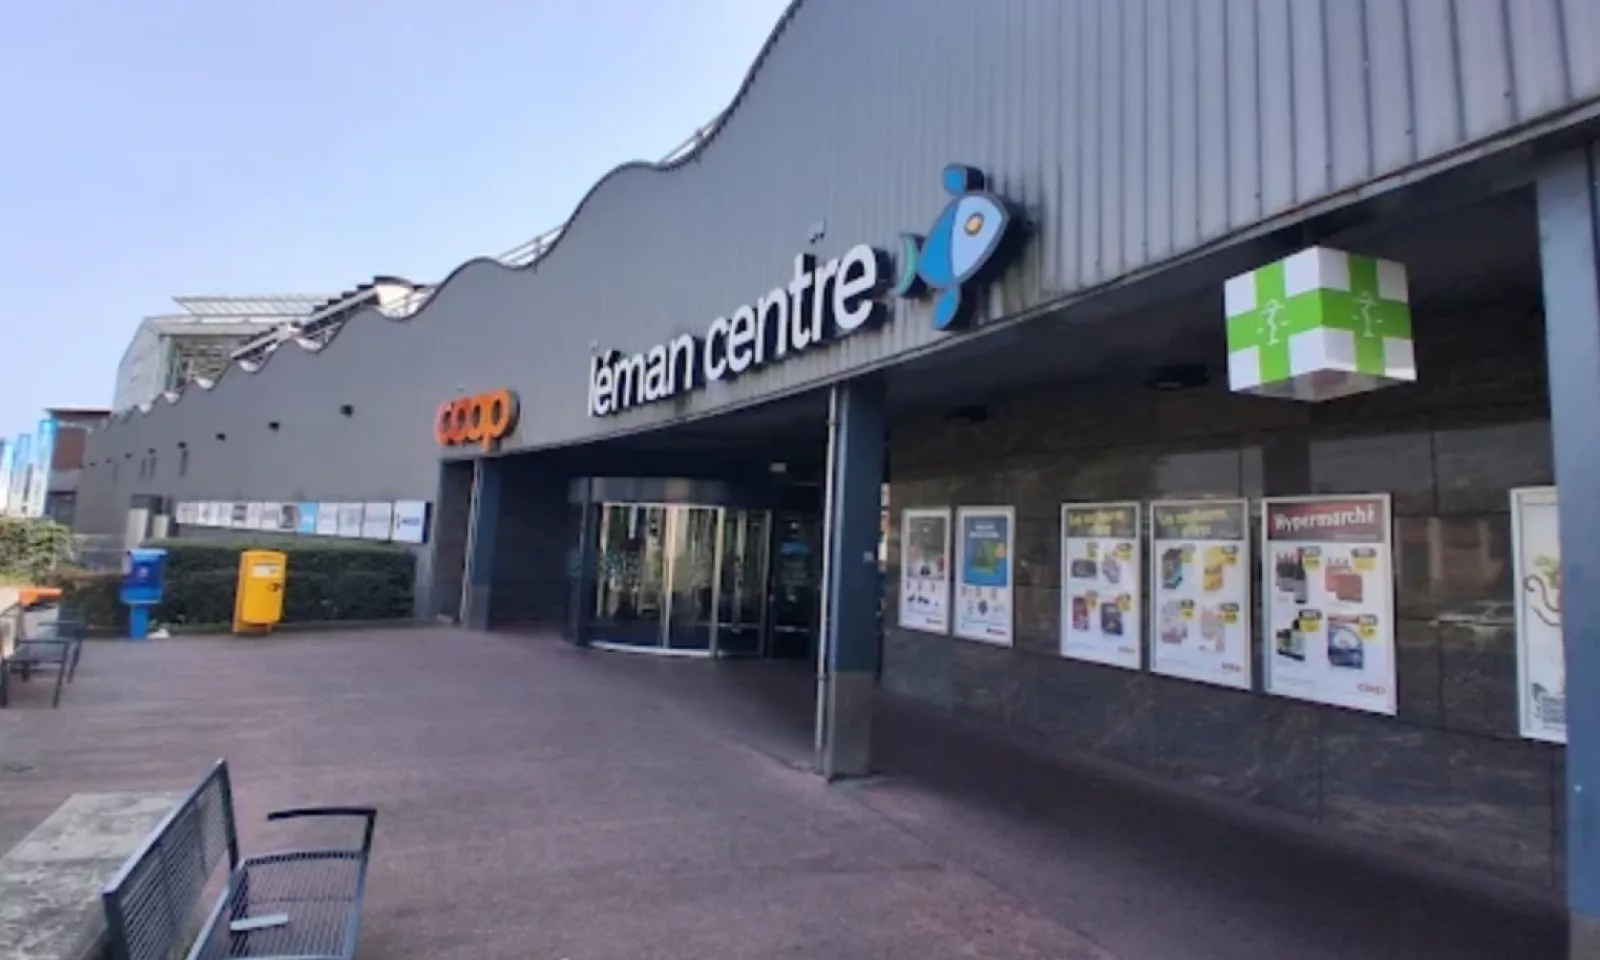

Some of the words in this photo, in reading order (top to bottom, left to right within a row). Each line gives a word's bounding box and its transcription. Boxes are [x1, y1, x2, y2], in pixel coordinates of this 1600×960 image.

[588, 333, 694, 417] léman
[704, 244, 877, 380] centre
[436, 387, 511, 453] coop
